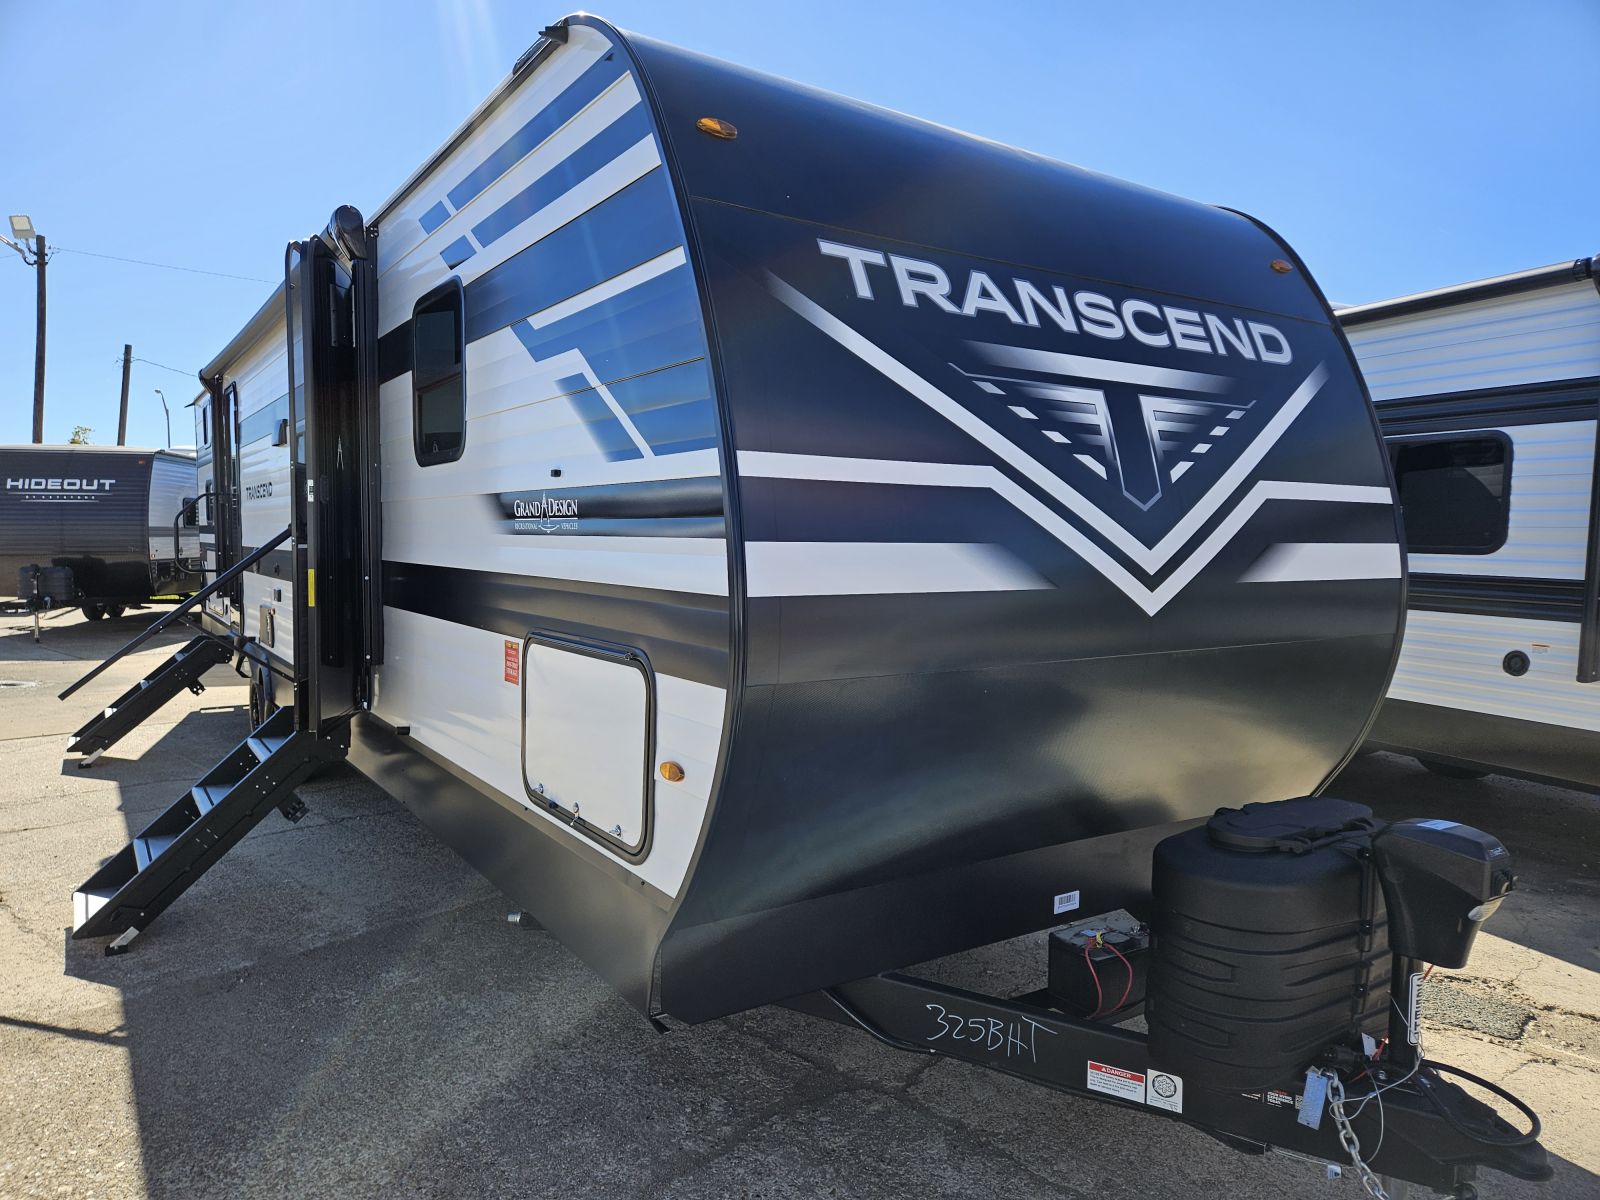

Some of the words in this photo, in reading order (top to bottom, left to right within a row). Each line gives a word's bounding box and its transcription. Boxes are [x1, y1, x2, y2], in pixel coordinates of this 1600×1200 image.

[816, 238, 1294, 366] TRANSCEND
[6, 478, 116, 490] HIDEOUT
[245, 481, 272, 500] TRANSCEND
[514, 500, 540, 516] GRAND
[548, 498, 578, 516] DESIGN
[926, 1004, 1059, 1063] 325BHT
[1106, 1067, 1132, 1079] DANGER
